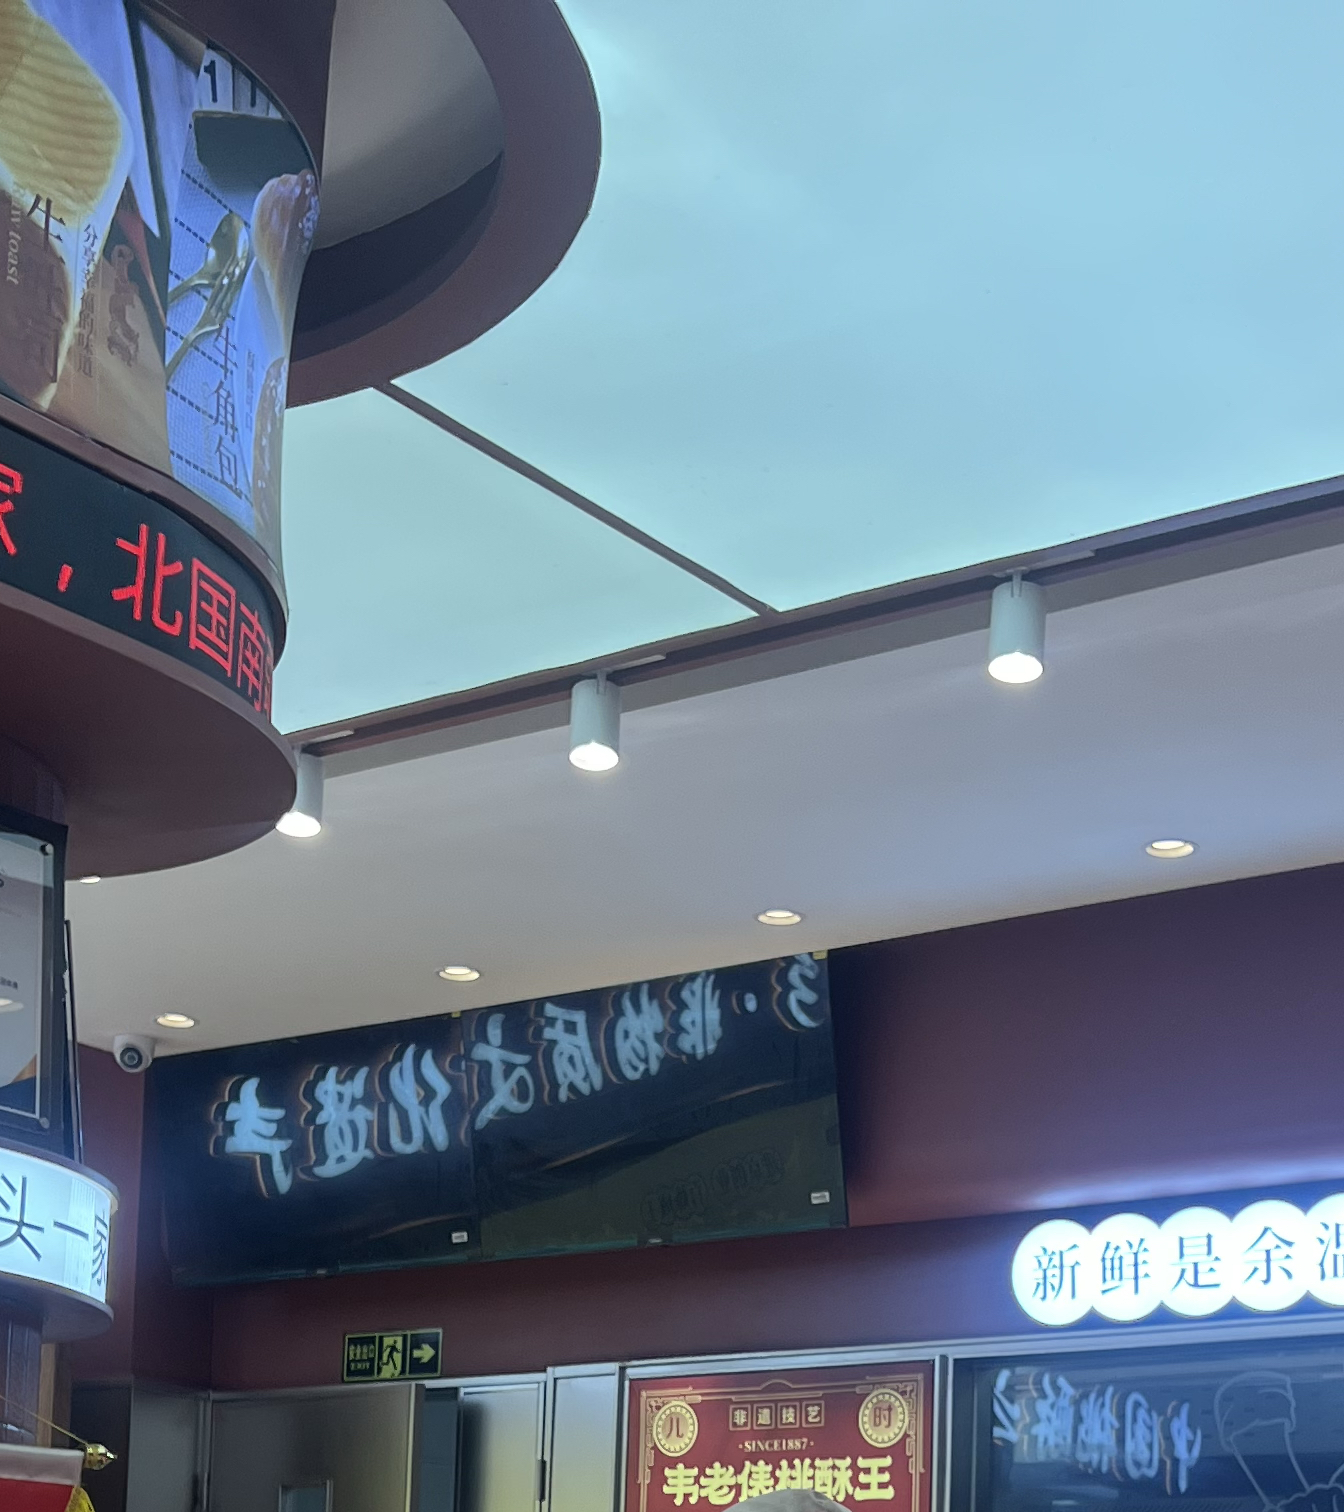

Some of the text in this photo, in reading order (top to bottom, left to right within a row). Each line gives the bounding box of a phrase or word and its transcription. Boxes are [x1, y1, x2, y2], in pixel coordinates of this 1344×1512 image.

[6, 229, 23, 286] toast
[213, 322, 239, 492] 牛角包
[732, 1405, 822, 1427] 非遗技艺
